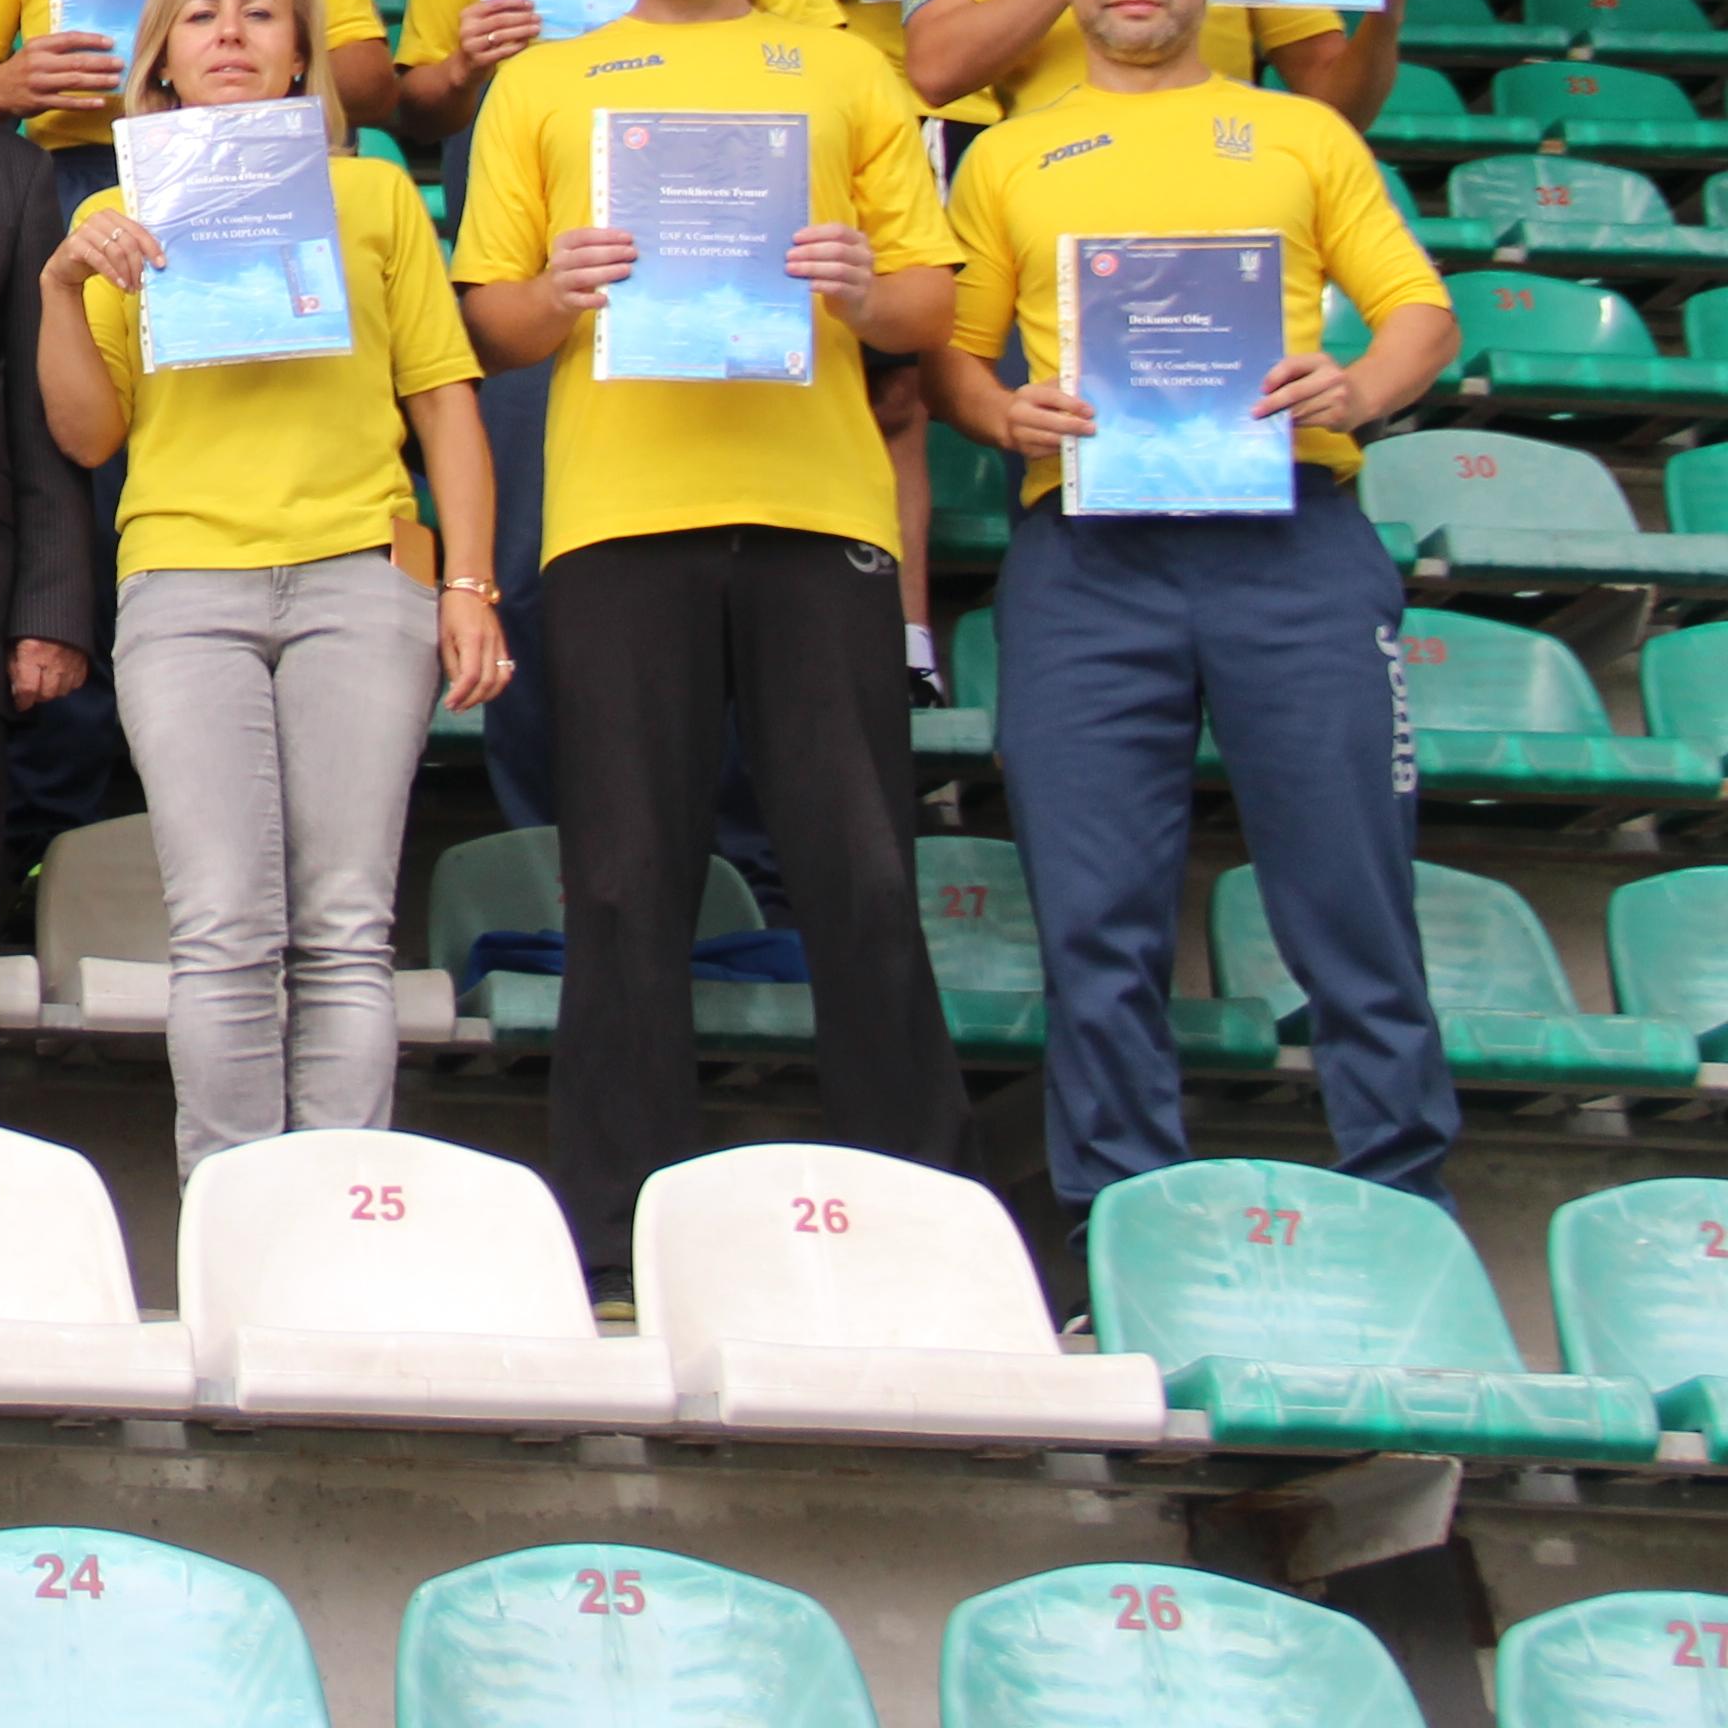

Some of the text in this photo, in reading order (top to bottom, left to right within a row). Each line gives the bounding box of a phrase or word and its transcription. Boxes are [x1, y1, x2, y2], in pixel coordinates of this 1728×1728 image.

[1568, 77, 1598, 94] 33
[1536, 186, 1571, 206] 32
[660, 247, 751, 257] UEFA A DIPLOMA
[1494, 288, 1533, 310] 31
[1456, 454, 1497, 479] 30
[1402, 636, 1448, 665] 29
[941, 886, 988, 918] 27
[351, 1185, 404, 1220] 25
[792, 1197, 848, 1232] 26
[1245, 1207, 1301, 1245] 27
[1700, 1222, 1728, 1258] 2
[36, 1556, 105, 1598] 24
[577, 1570, 644, 1614] 25
[1112, 1586, 1181, 1630] 26
[1668, 1621, 1728, 1667] 27
